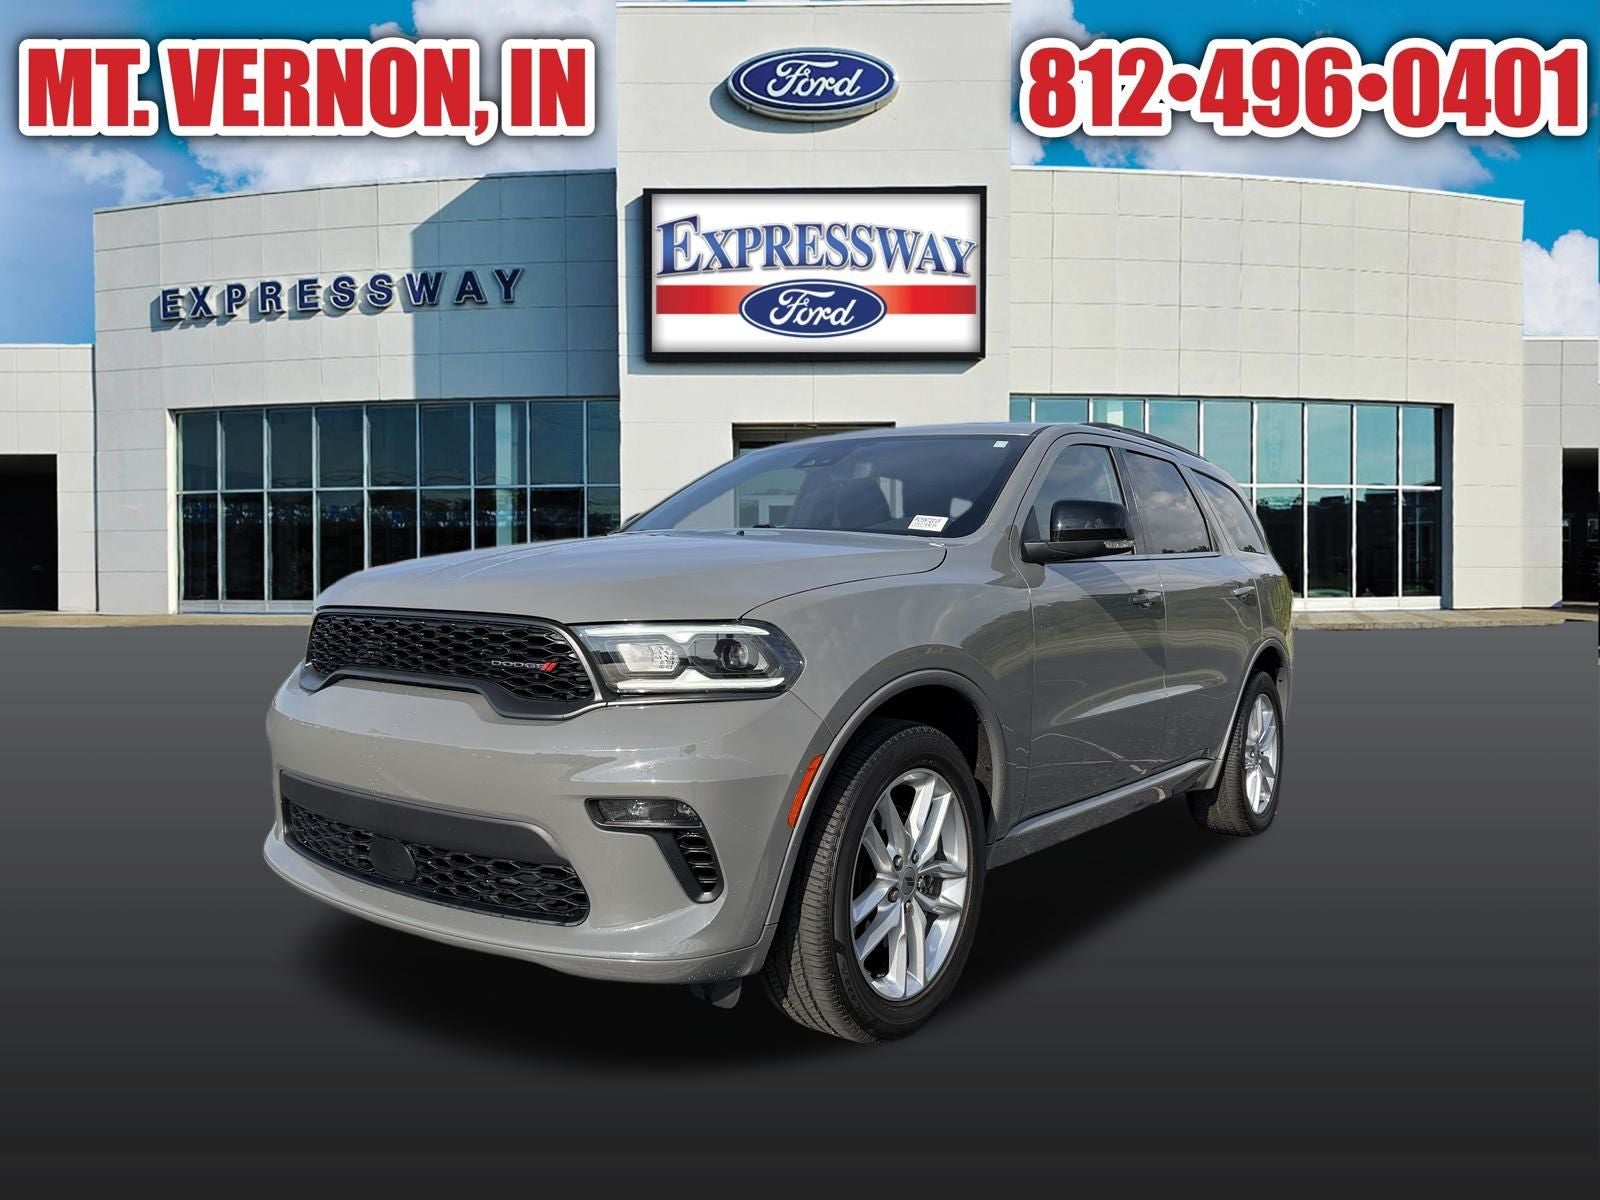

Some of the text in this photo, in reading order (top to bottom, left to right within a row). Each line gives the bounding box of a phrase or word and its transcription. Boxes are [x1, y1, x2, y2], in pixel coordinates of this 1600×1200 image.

[766, 60, 863, 97] Ford
[159, 268, 524, 321] EXPRESSWAY
[769, 289, 857, 326] Ford
[491, 660, 544, 670] DODGE
